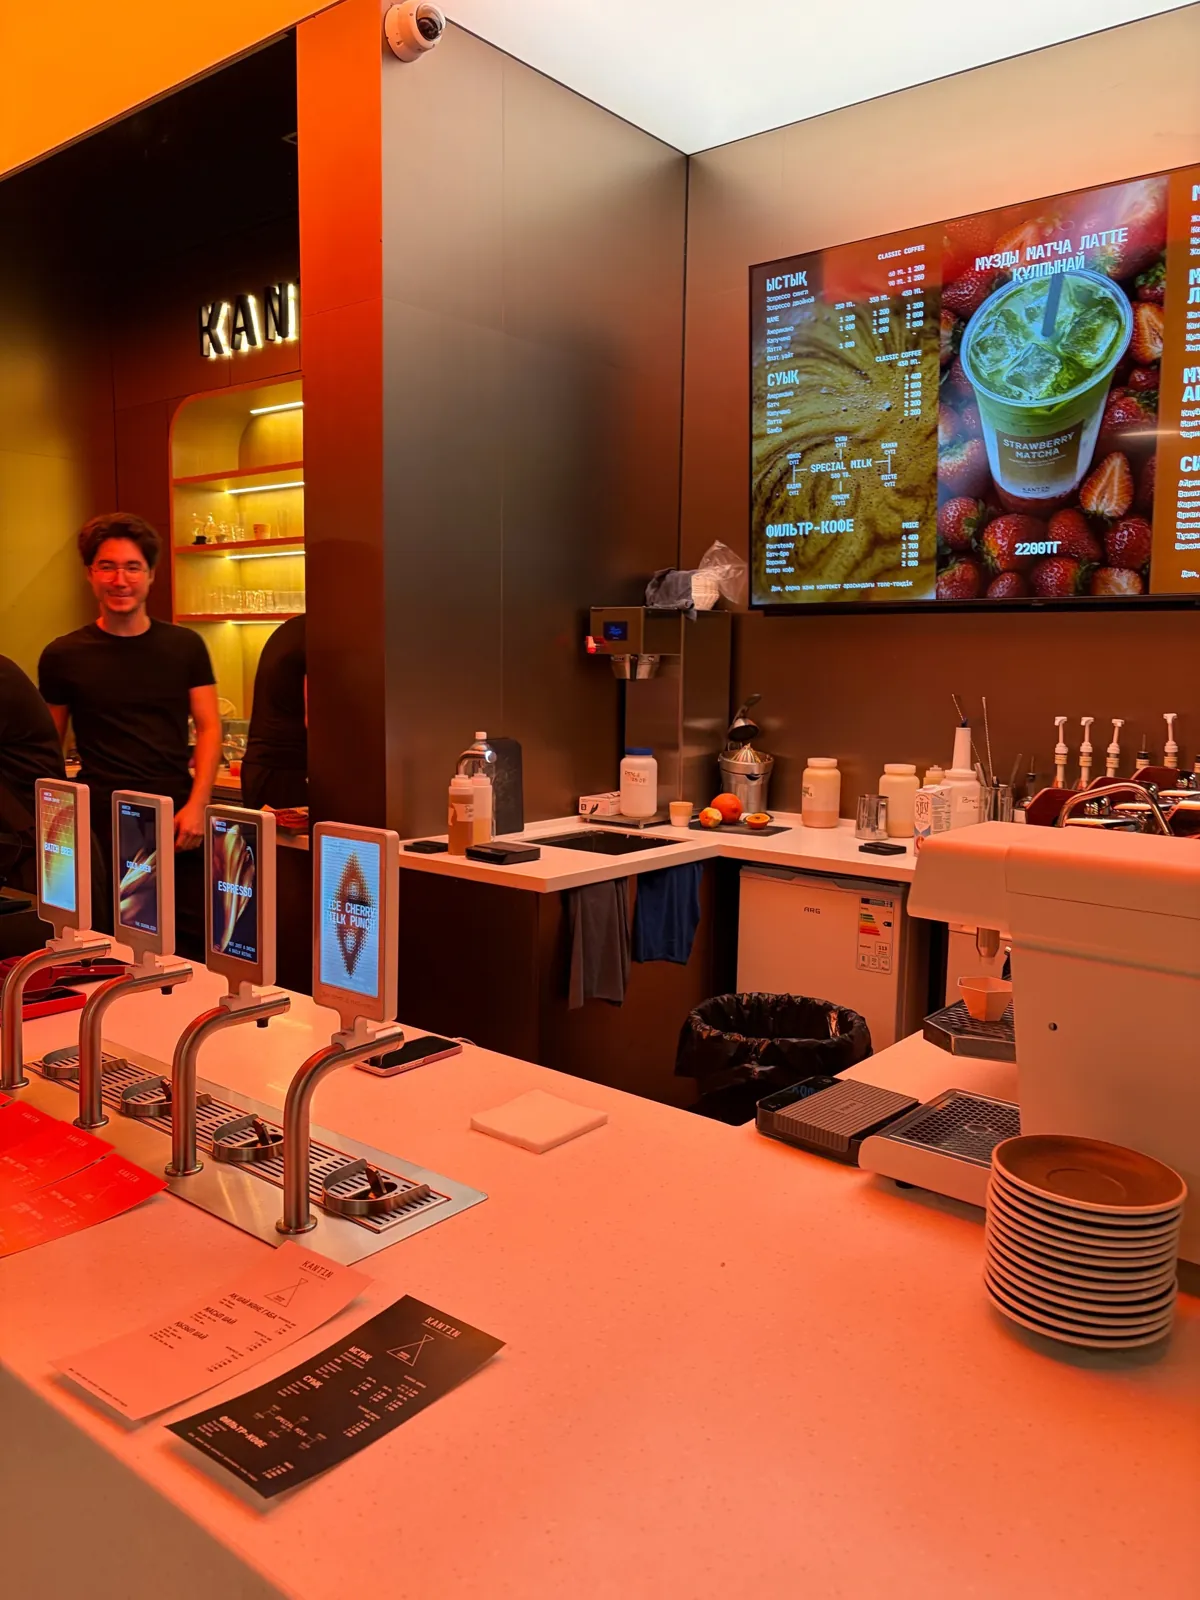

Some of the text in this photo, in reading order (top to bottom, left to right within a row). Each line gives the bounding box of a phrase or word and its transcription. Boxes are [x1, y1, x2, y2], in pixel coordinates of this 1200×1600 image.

[877, 244, 925, 260] CLASSIC COFFEE
[974, 227, 1129, 272] МҰЗДЫ МАТЧА ЛАТТЕ
[1012, 252, 1085, 283] ҚҰЛПЫНАЙ
[766, 271, 808, 292] ЫСТЫҚ
[199, 278, 300, 359] KAN
[875, 349, 922, 363] CLASSIC COFFEE
[767, 369, 799, 387] СУЫҚ
[1003, 432, 1075, 451] STRAWBERRY
[1015, 447, 1060, 459] MATCHA
[810, 458, 872, 473] SPECIAL MILK
[766, 519, 854, 538] ФИЛЬТР-КОФЕ
[901, 521, 919, 529] PRICE
[217, 880, 253, 898] ESPRESSO
[302, 1260, 334, 1278] KANTIN
[424, 1316, 462, 1338] KANTIN
